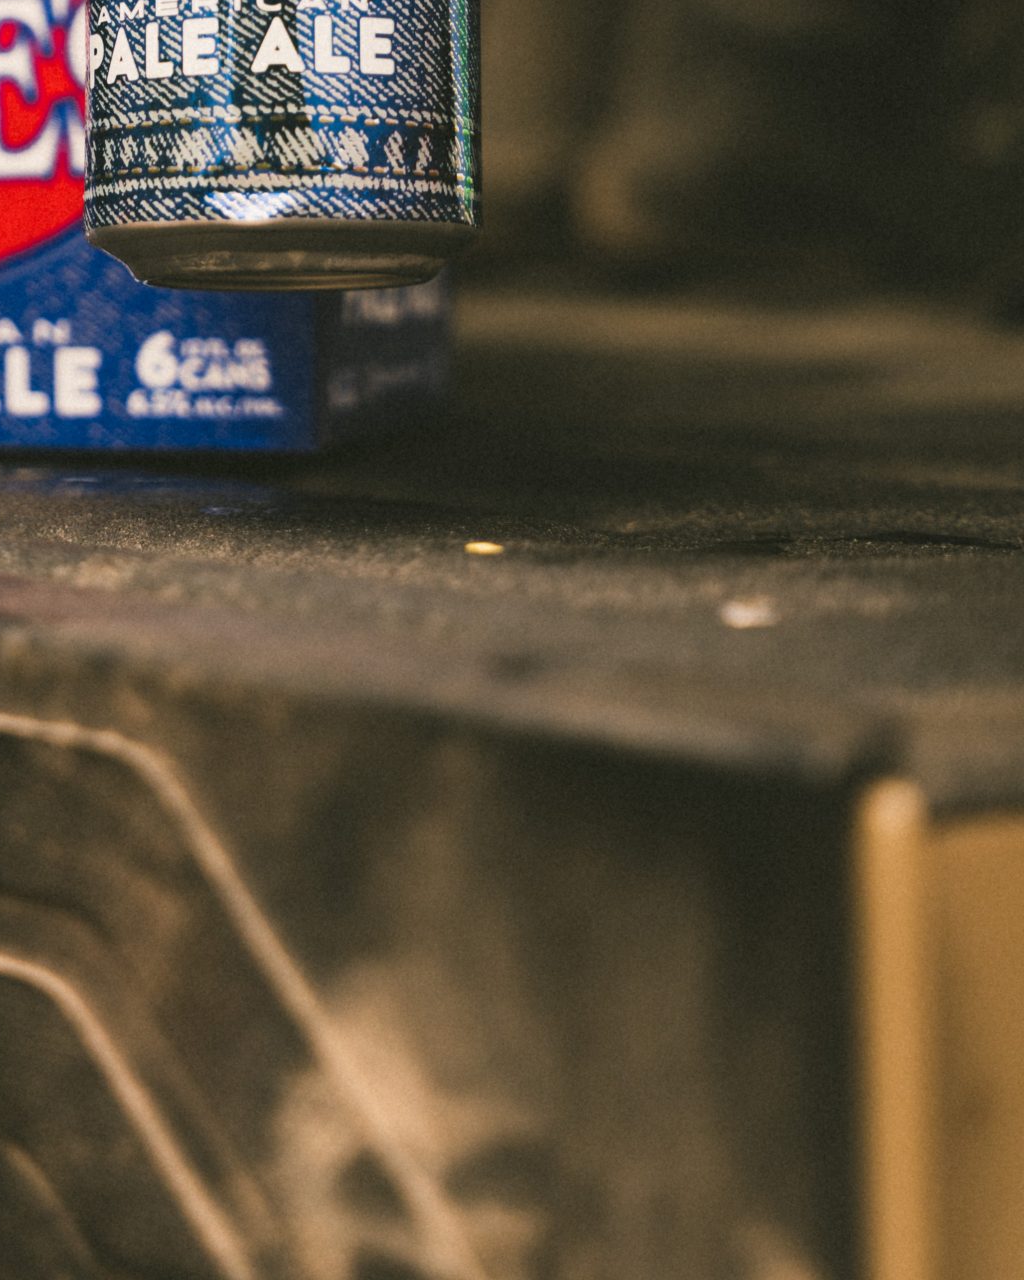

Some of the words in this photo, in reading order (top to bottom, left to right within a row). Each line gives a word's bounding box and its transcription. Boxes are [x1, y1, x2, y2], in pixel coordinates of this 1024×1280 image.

[88, 16, 220, 90] PALE
[250, 15, 396, 76] ALE
[135, 330, 178, 390] 6
